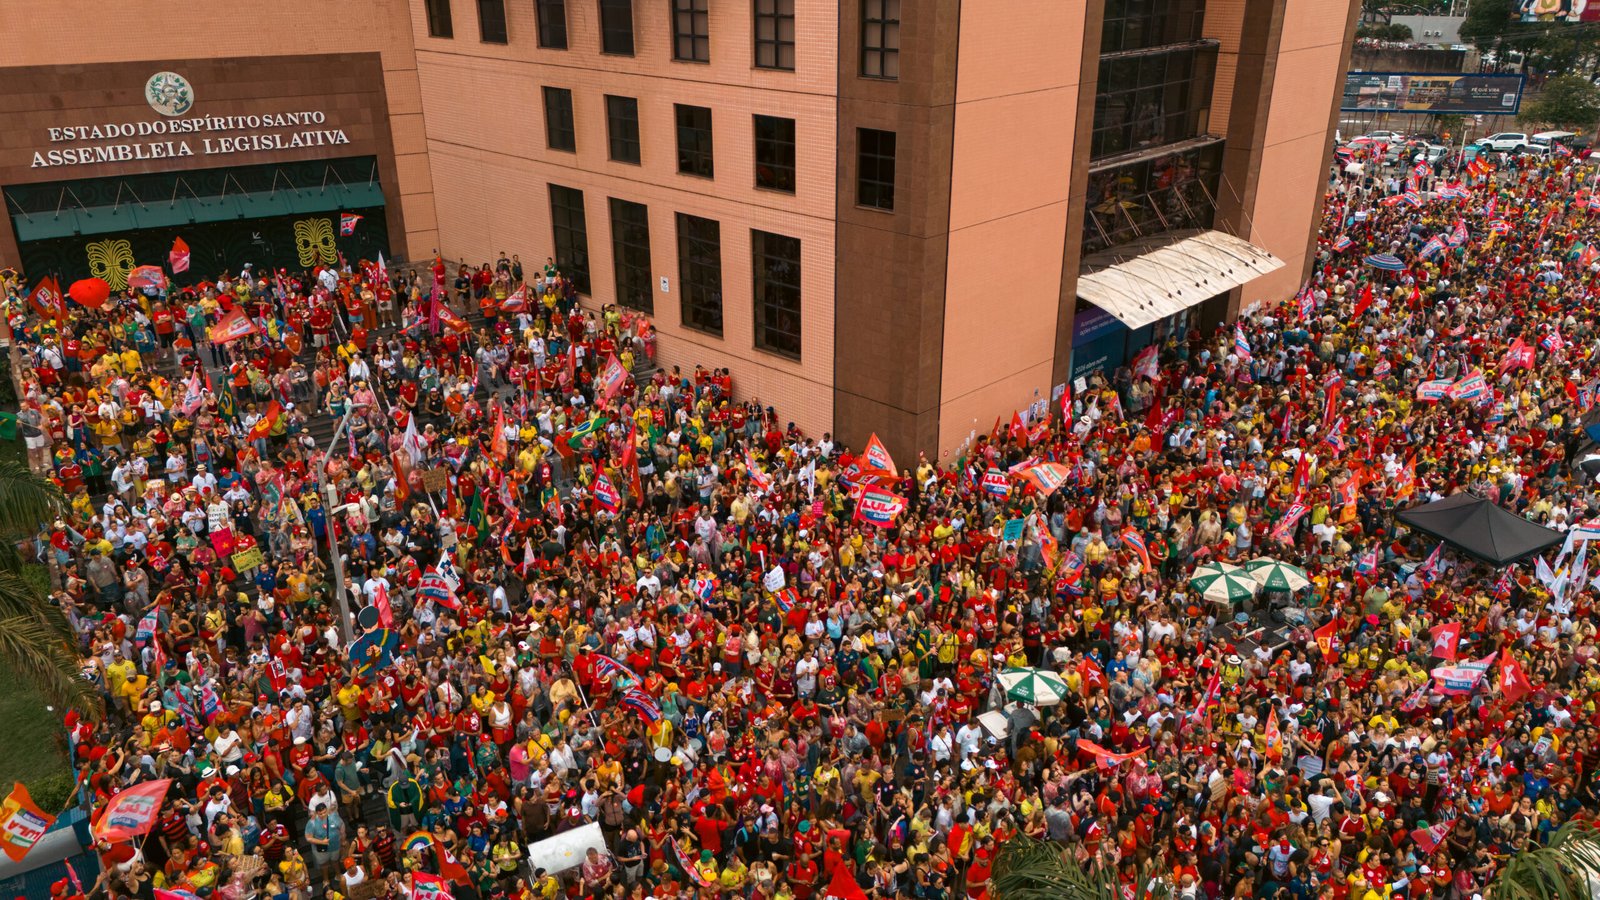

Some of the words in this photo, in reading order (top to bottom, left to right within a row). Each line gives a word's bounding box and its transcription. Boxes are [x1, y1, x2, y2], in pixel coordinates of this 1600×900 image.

[48, 124, 136, 142] ESTADO
[137, 121, 167, 136] DO
[168, 114, 261, 134] ESPÍRITO
[263, 111, 325, 128] SANTO
[31, 141, 195, 168] ASSEMBLEIA
[203, 129, 350, 155] LEGISLATIVA
[862, 500, 897, 512] LULA
